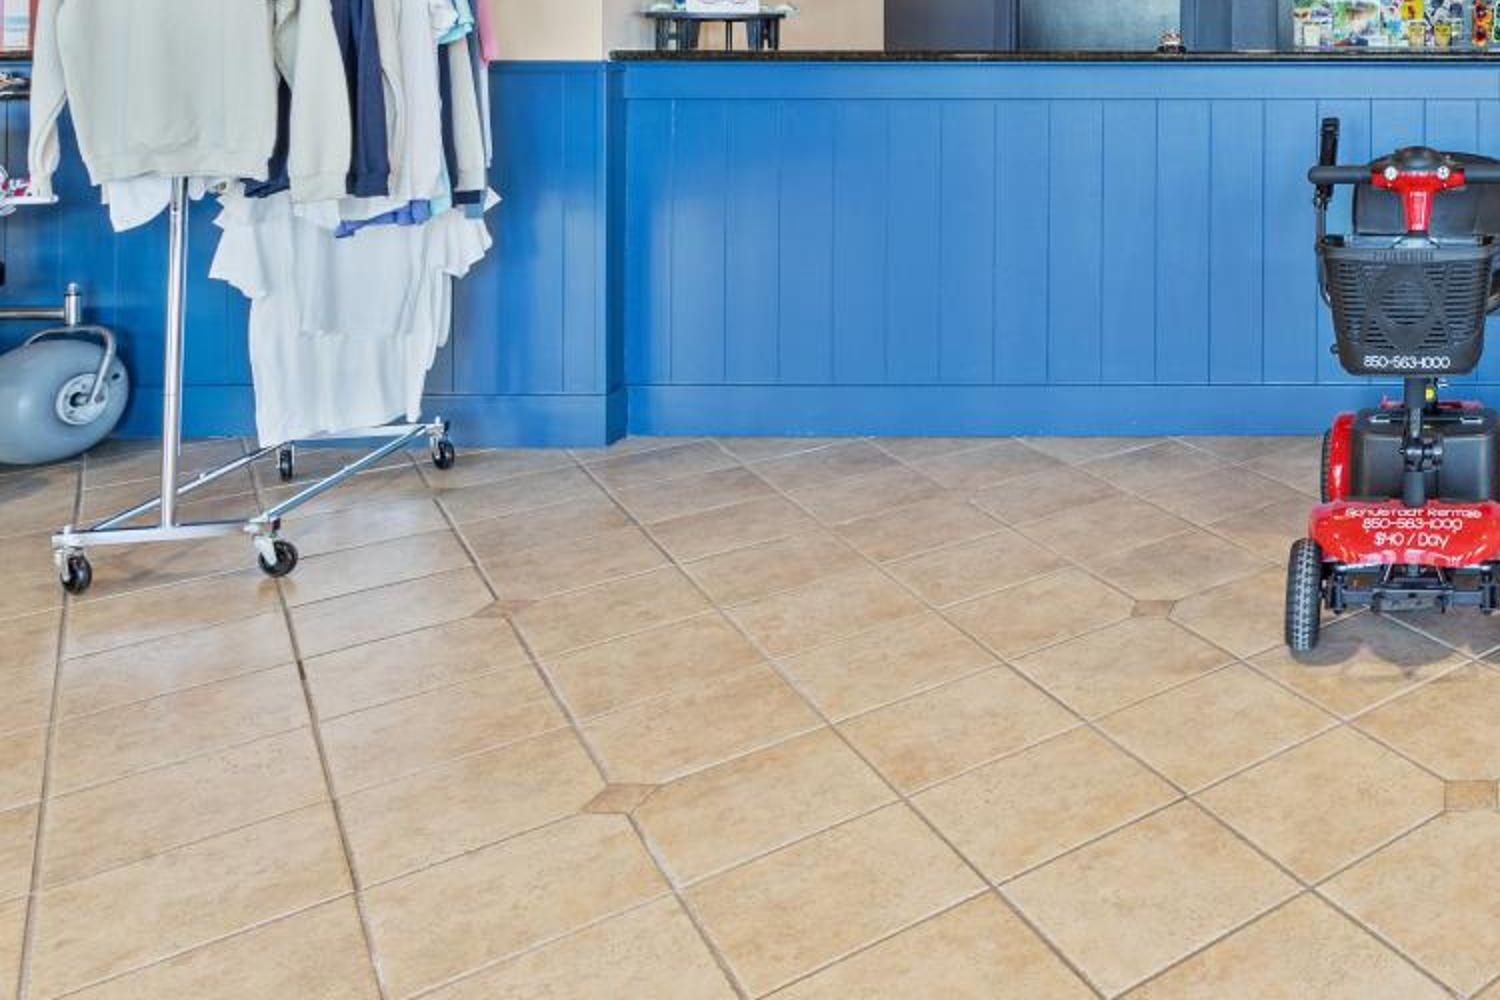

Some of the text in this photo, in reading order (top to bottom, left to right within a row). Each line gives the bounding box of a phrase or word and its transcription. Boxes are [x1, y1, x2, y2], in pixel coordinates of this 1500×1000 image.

[1363, 354, 1450, 369] 850-563-1000
[1345, 507, 1423, 518] Schulstadt
[1374, 532, 1404, 547] $40
[1418, 532, 1450, 549] Day
